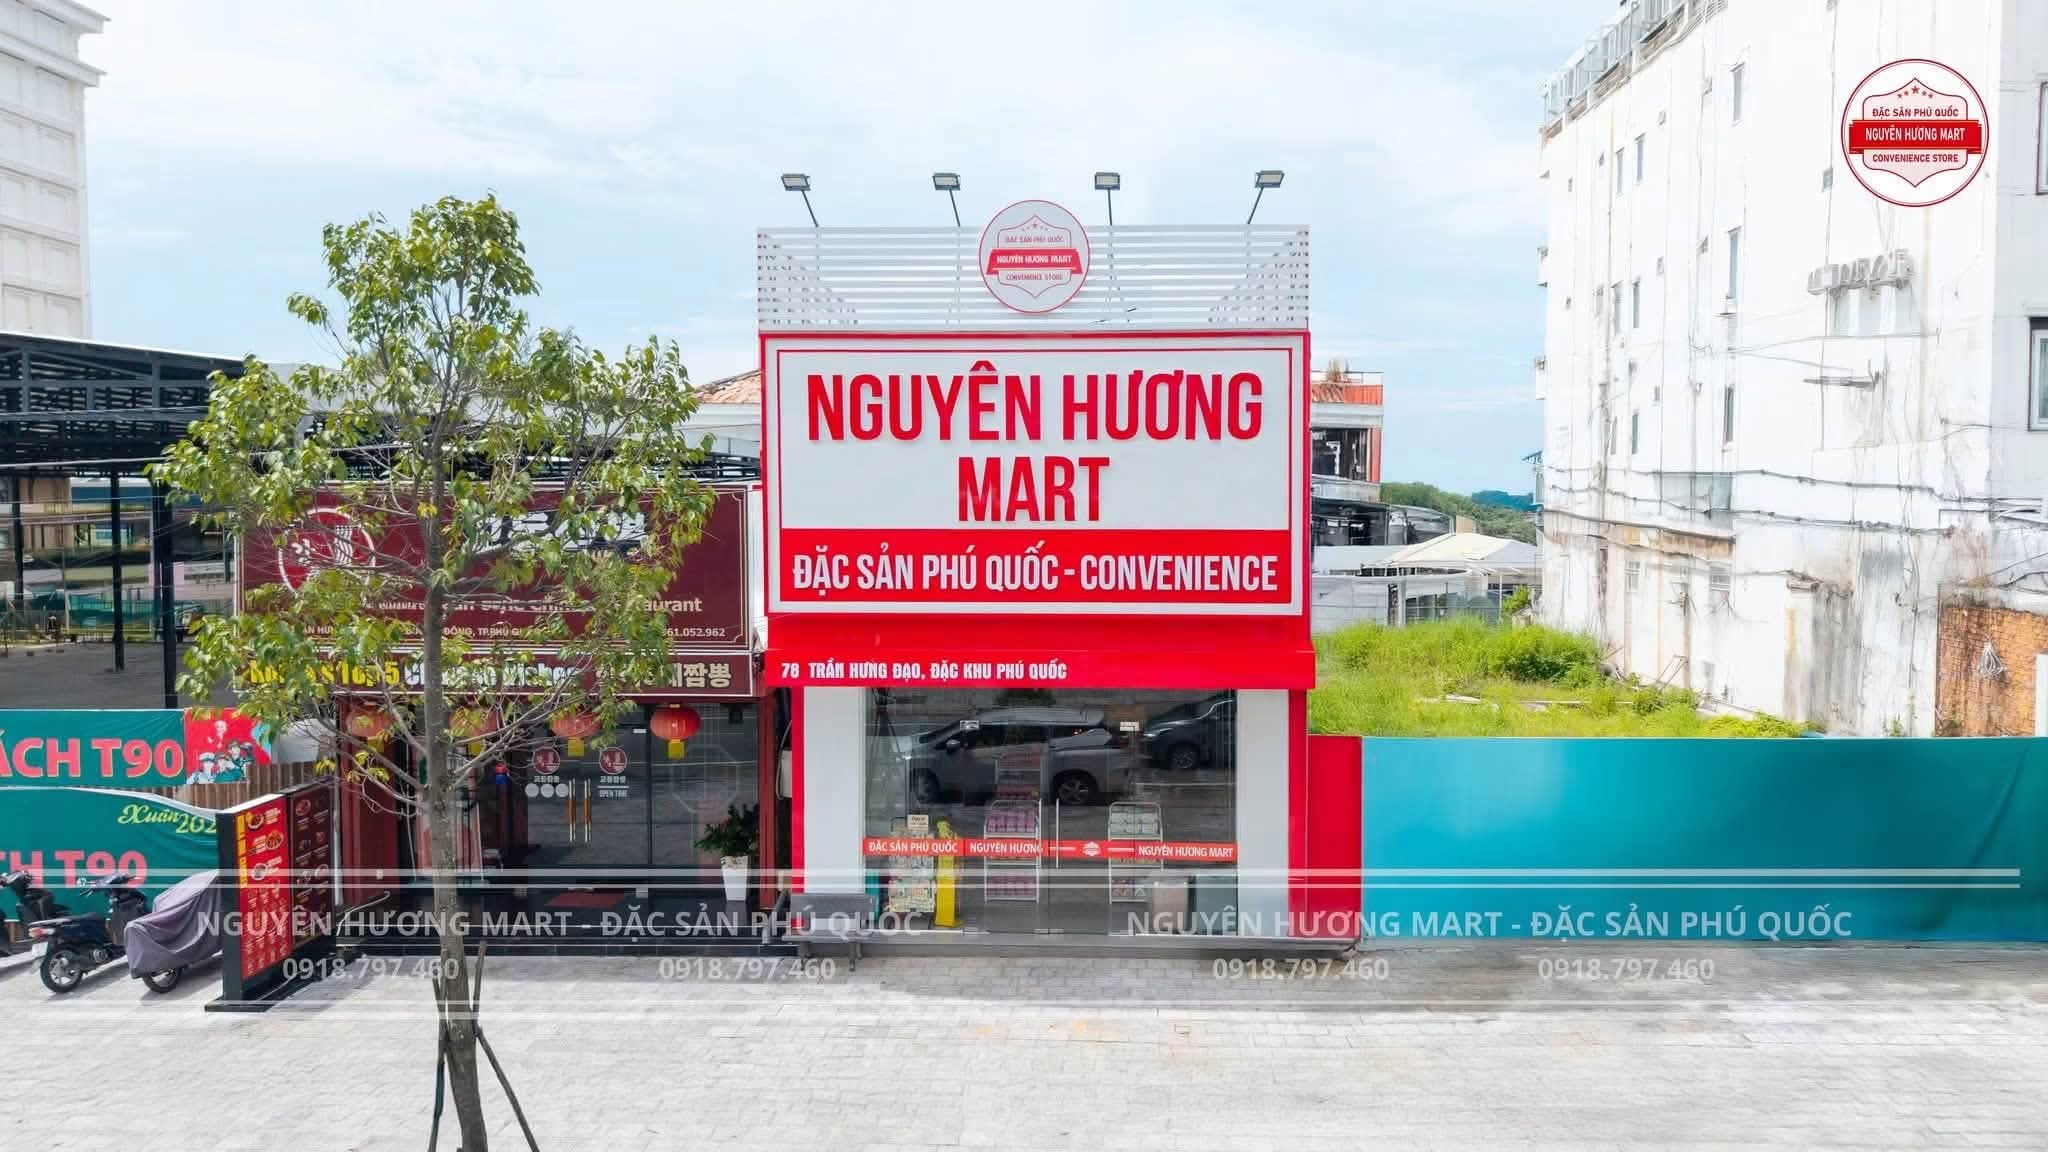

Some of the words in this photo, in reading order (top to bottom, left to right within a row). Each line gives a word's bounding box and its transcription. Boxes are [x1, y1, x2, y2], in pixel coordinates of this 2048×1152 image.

[808, 360, 1041, 440] NGUYÊN
[1062, 370, 1262, 440] HƯƠNG
[957, 456, 1110, 521] MART
[793, 545, 850, 596] ĐẶC
[856, 542, 913, 590] SẢN
[922, 545, 977, 590] PHÚ
[985, 540, 1059, 591] QUỐC
[1080, 554, 1278, 591] CONVENIENCE
[662, 627, 726, 637] 61.052.962
[781, 663, 800, 679] 78
[808, 657, 845, 679] TRẦN
[850, 660, 887, 679] HƯNG
[893, 662, 925, 682] ĐẠO,
[931, 659, 959, 682] ĐẶC
[963, 663, 991, 679] KHU
[996, 658, 1024, 679] PHÚ
[1029, 658, 1067, 679] QUỐC
[91, 738, 184, 778] T90
[55, 850, 148, 888] T90
[1138, 844, 1174, 857] NGUYÊN
[1209, 847, 1233, 858] MART
